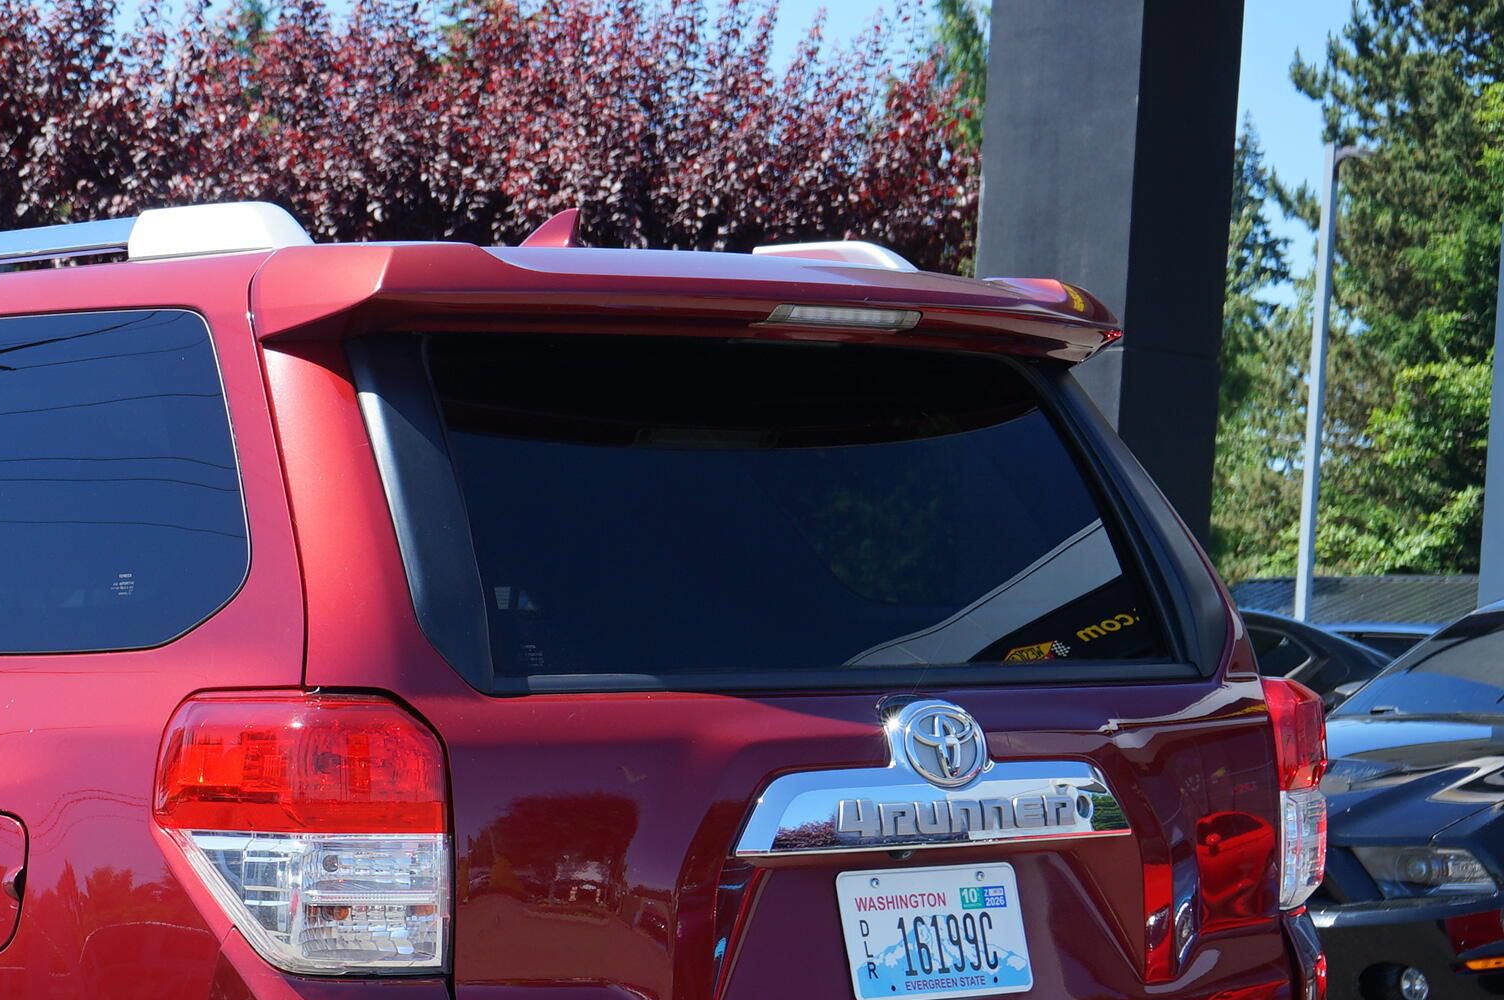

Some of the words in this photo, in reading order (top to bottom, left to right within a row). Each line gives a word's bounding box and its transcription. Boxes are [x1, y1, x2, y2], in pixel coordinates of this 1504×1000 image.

[855, 892, 948, 912] WASHINGTON
[961, 889, 977, 903] 10
[897, 912, 999, 976] 16199C
[905, 977, 958, 991] EVERGREEN
[959, 975, 986, 988] STATE
